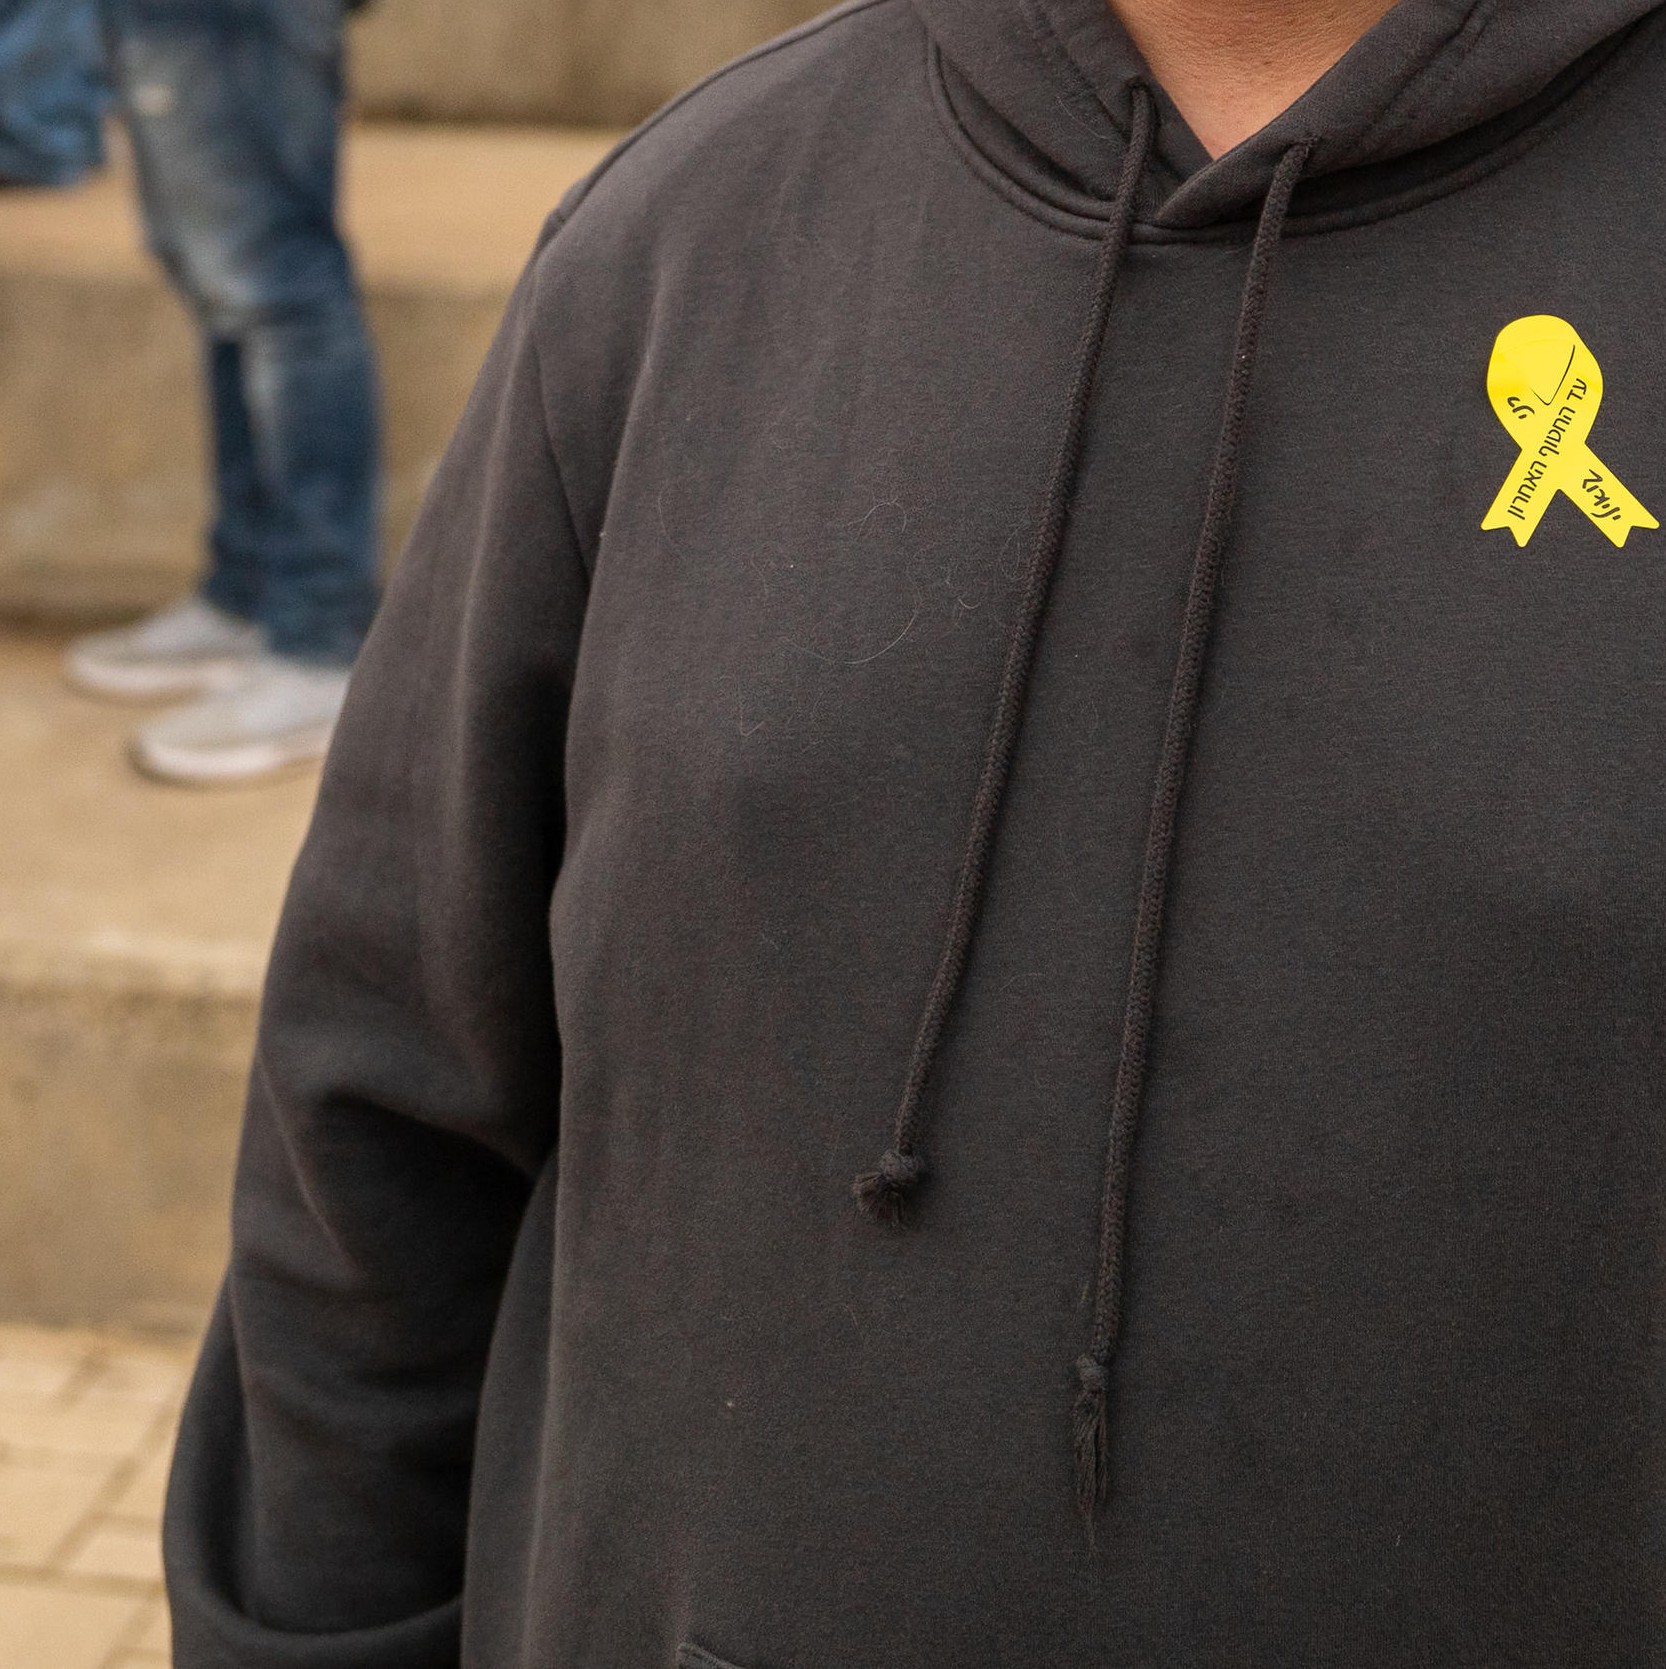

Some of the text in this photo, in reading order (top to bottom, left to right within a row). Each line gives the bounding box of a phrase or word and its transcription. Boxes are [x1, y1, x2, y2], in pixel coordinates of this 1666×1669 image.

[1506, 396, 1622, 521] רני גואילי
[1507, 377, 1587, 521] עד החטוף האחרון
